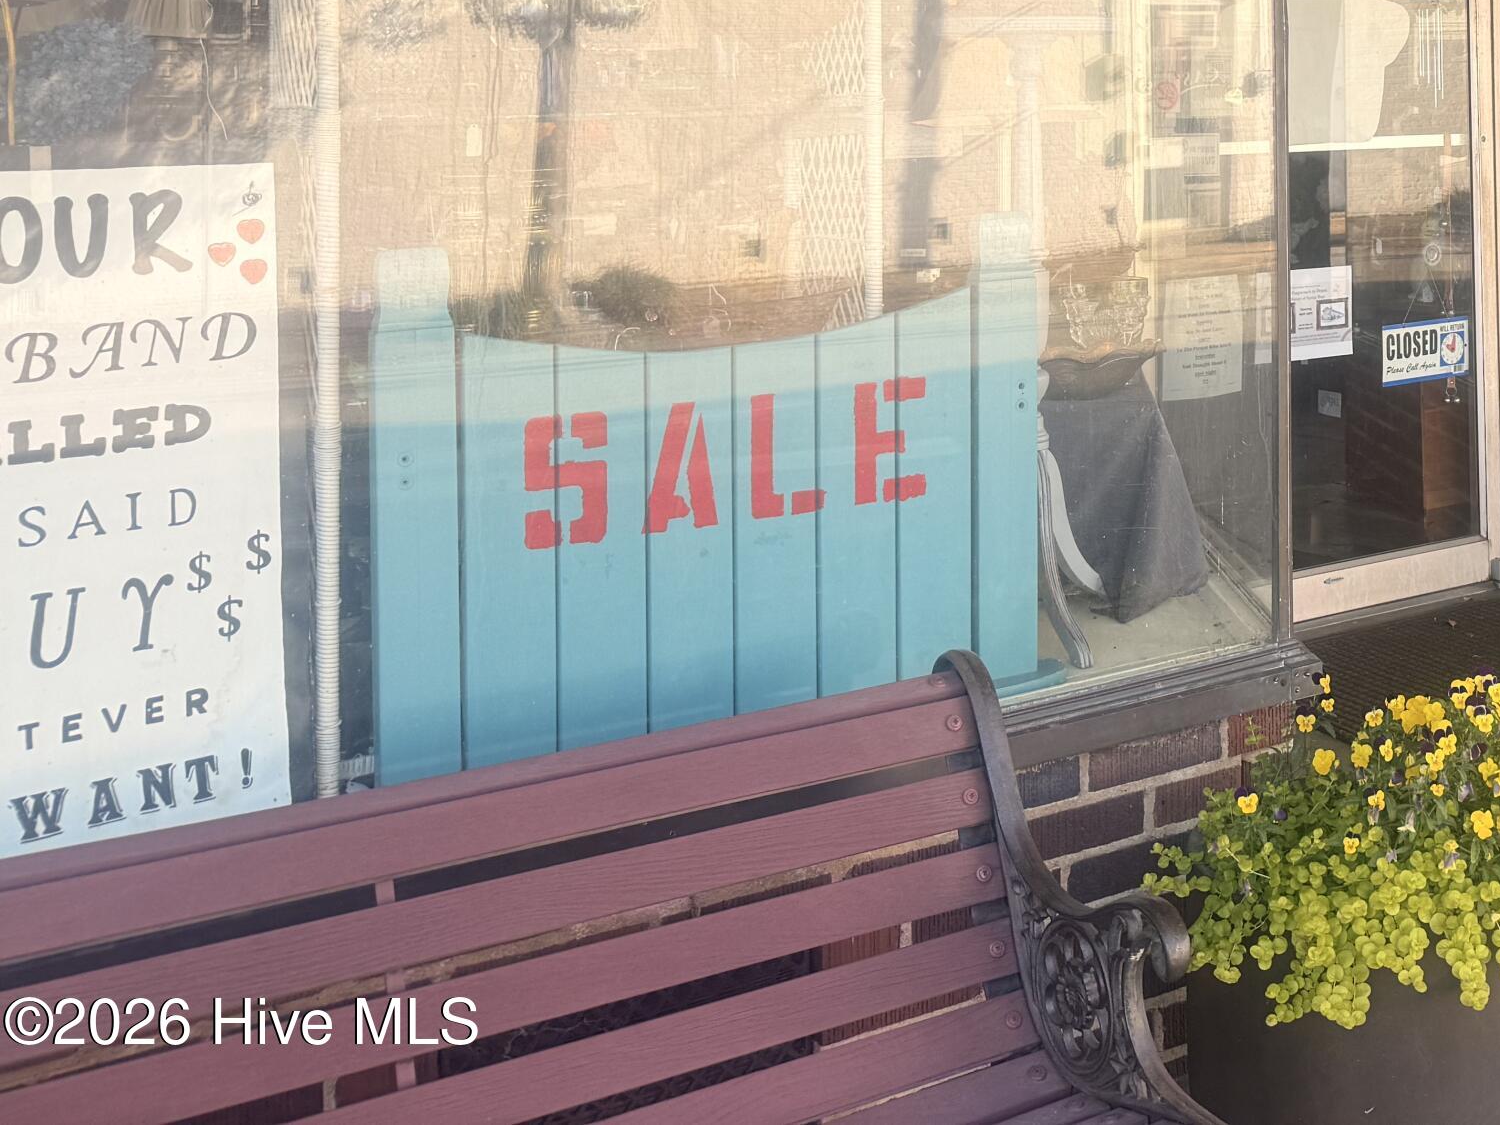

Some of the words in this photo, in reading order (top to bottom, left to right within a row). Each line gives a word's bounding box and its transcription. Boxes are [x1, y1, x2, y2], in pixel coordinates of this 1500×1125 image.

[0, 189, 193, 284] OUR
[5, 312, 257, 384] BAND
[1385, 365, 1405, 376] Please
[1406, 361, 1419, 373] Call
[1420, 360, 1437, 371] Again
[1386, 328, 1438, 361] CLOSED
[0, 403, 212, 466] LLED
[523, 375, 928, 550] SALE
[17, 488, 198, 548] SAID
[17, 687, 210, 751] TEVER
[8, 747, 254, 844] WANT!
